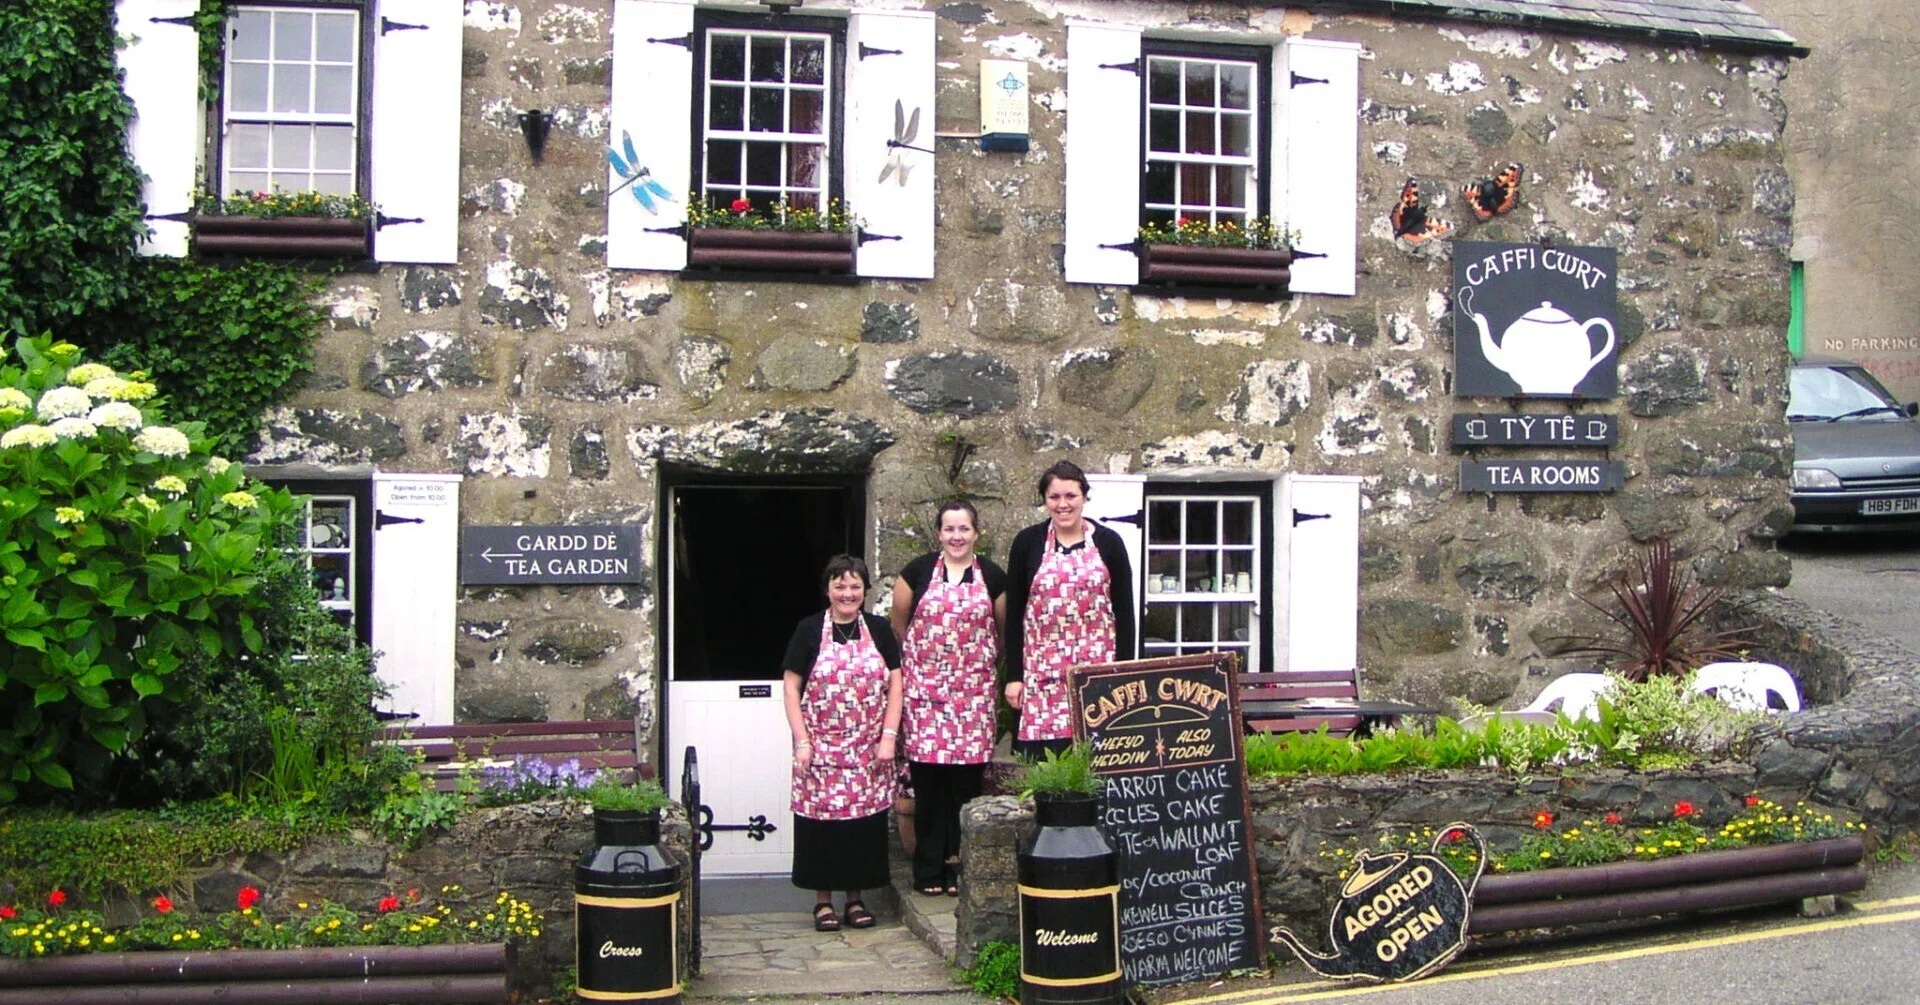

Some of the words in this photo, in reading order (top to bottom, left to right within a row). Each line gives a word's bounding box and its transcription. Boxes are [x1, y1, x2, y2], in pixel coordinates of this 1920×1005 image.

[1466, 248, 1535, 285] CAFFI
[1542, 249, 1607, 290] CWRT
[1825, 338, 1844, 350] NO
[1852, 337, 1919, 350] PARKING
[1487, 466, 1524, 485] TEA
[1531, 466, 1600, 485] ROOMS
[1868, 500, 1892, 512] H89
[1894, 499, 1918, 511] FDH
[517, 534, 587, 551] GARDD
[505, 559, 542, 575] TEA
[548, 559, 628, 575] GARDEN
[1084, 680, 1148, 728] CAFFI
[1158, 677, 1228, 711] CWRT
[1099, 734, 1145, 751] HEFYD
[1176, 728, 1212, 744] ALSO
[1091, 750, 1150, 767] HEDDIW
[1168, 744, 1215, 760] TODAY
[1098, 773, 1166, 799] ARROT
[1175, 764, 1233, 793] CAKE
[1167, 794, 1226, 822] CAKE
[1195, 842, 1242, 865] LOAF
[1180, 881, 1247, 899] CRUNCH
[1121, 903, 1174, 926] KEWELL
[1175, 895, 1245, 921] SLICES
[1344, 865, 1433, 941] AGORED
[1035, 928, 1098, 946] Welcome
[1121, 929, 1169, 953] ROESO
[1376, 905, 1444, 962] OPEN
[599, 940, 643, 958] Croeso
[1122, 953, 1171, 982] WARM
[1174, 940, 1248, 973] WELCOME
